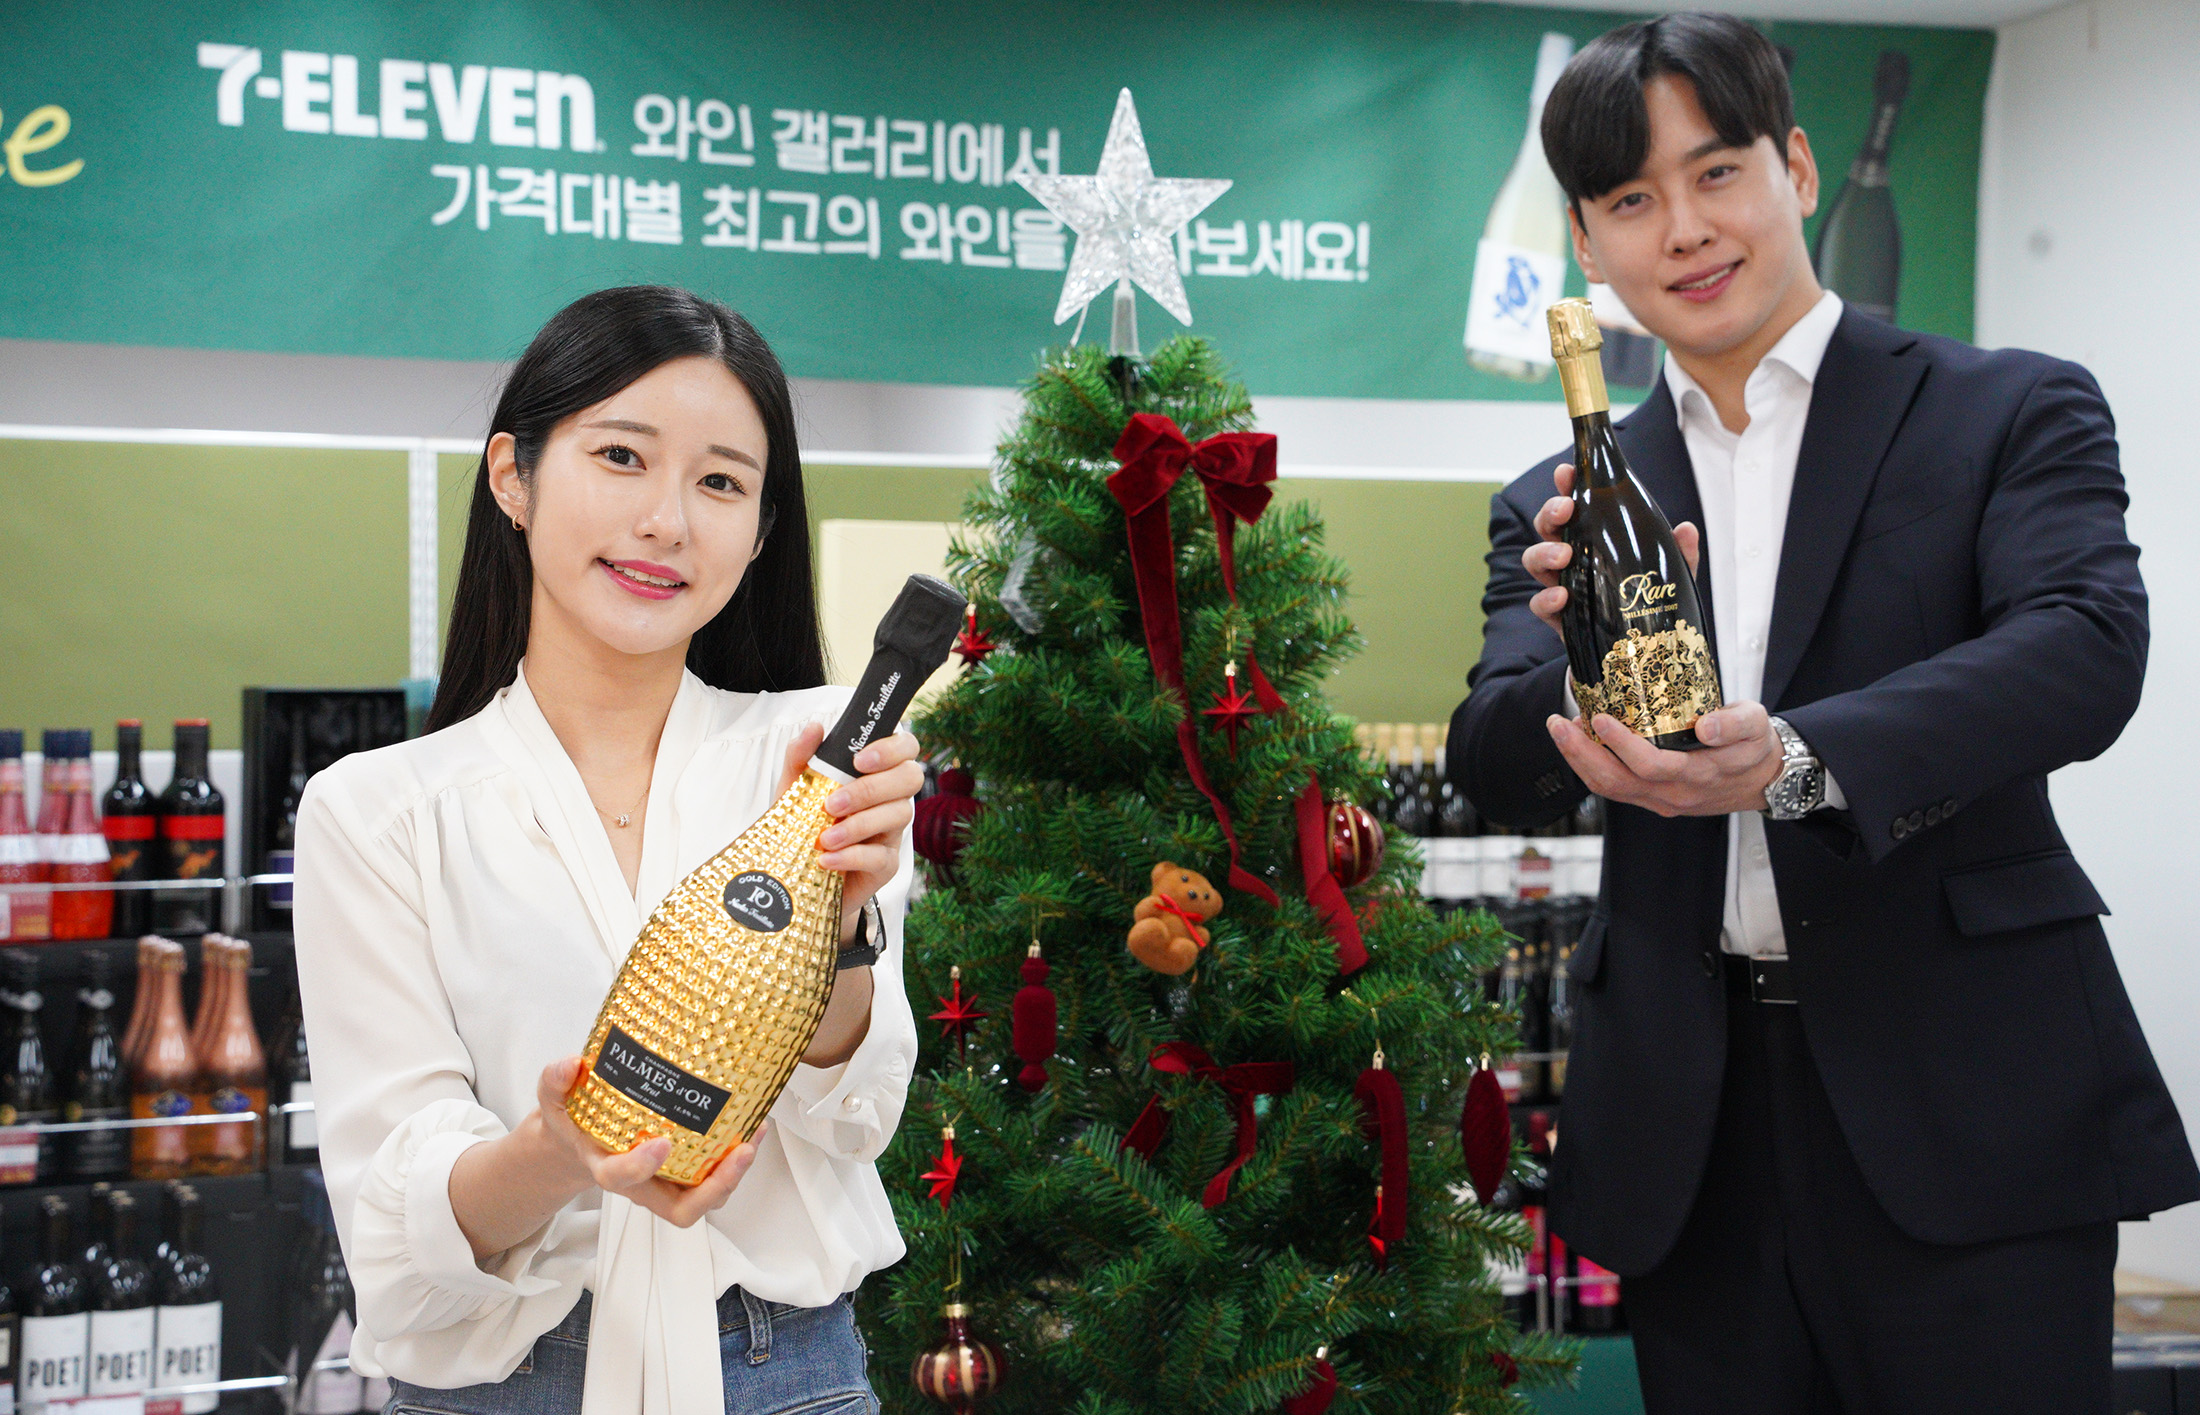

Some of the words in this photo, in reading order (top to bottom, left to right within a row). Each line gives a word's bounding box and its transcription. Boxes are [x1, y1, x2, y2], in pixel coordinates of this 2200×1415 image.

[0, 104, 86, 188] e
[631, 93, 755, 167] 와인
[771, 108, 1060, 187] 갤러리에서
[430, 163, 683, 245] 가격대별
[701, 184, 881, 260] 최고의
[900, 201, 1067, 271] 와인을
[1619, 570, 1677, 612] Rare
[847, 720, 876, 757] Nicolas
[867, 671, 901, 720] Feuillatte
[738, 875, 764, 885] GOLD
[766, 879, 791, 910] EDITION
[609, 1042, 677, 1093] PALMES
[676, 1086, 712, 1110] d'OR
[640, 1081, 661, 1098] Brut
[27, 1356, 81, 1388] POET
[95, 1350, 149, 1381] POET
[164, 1343, 215, 1375] POET
